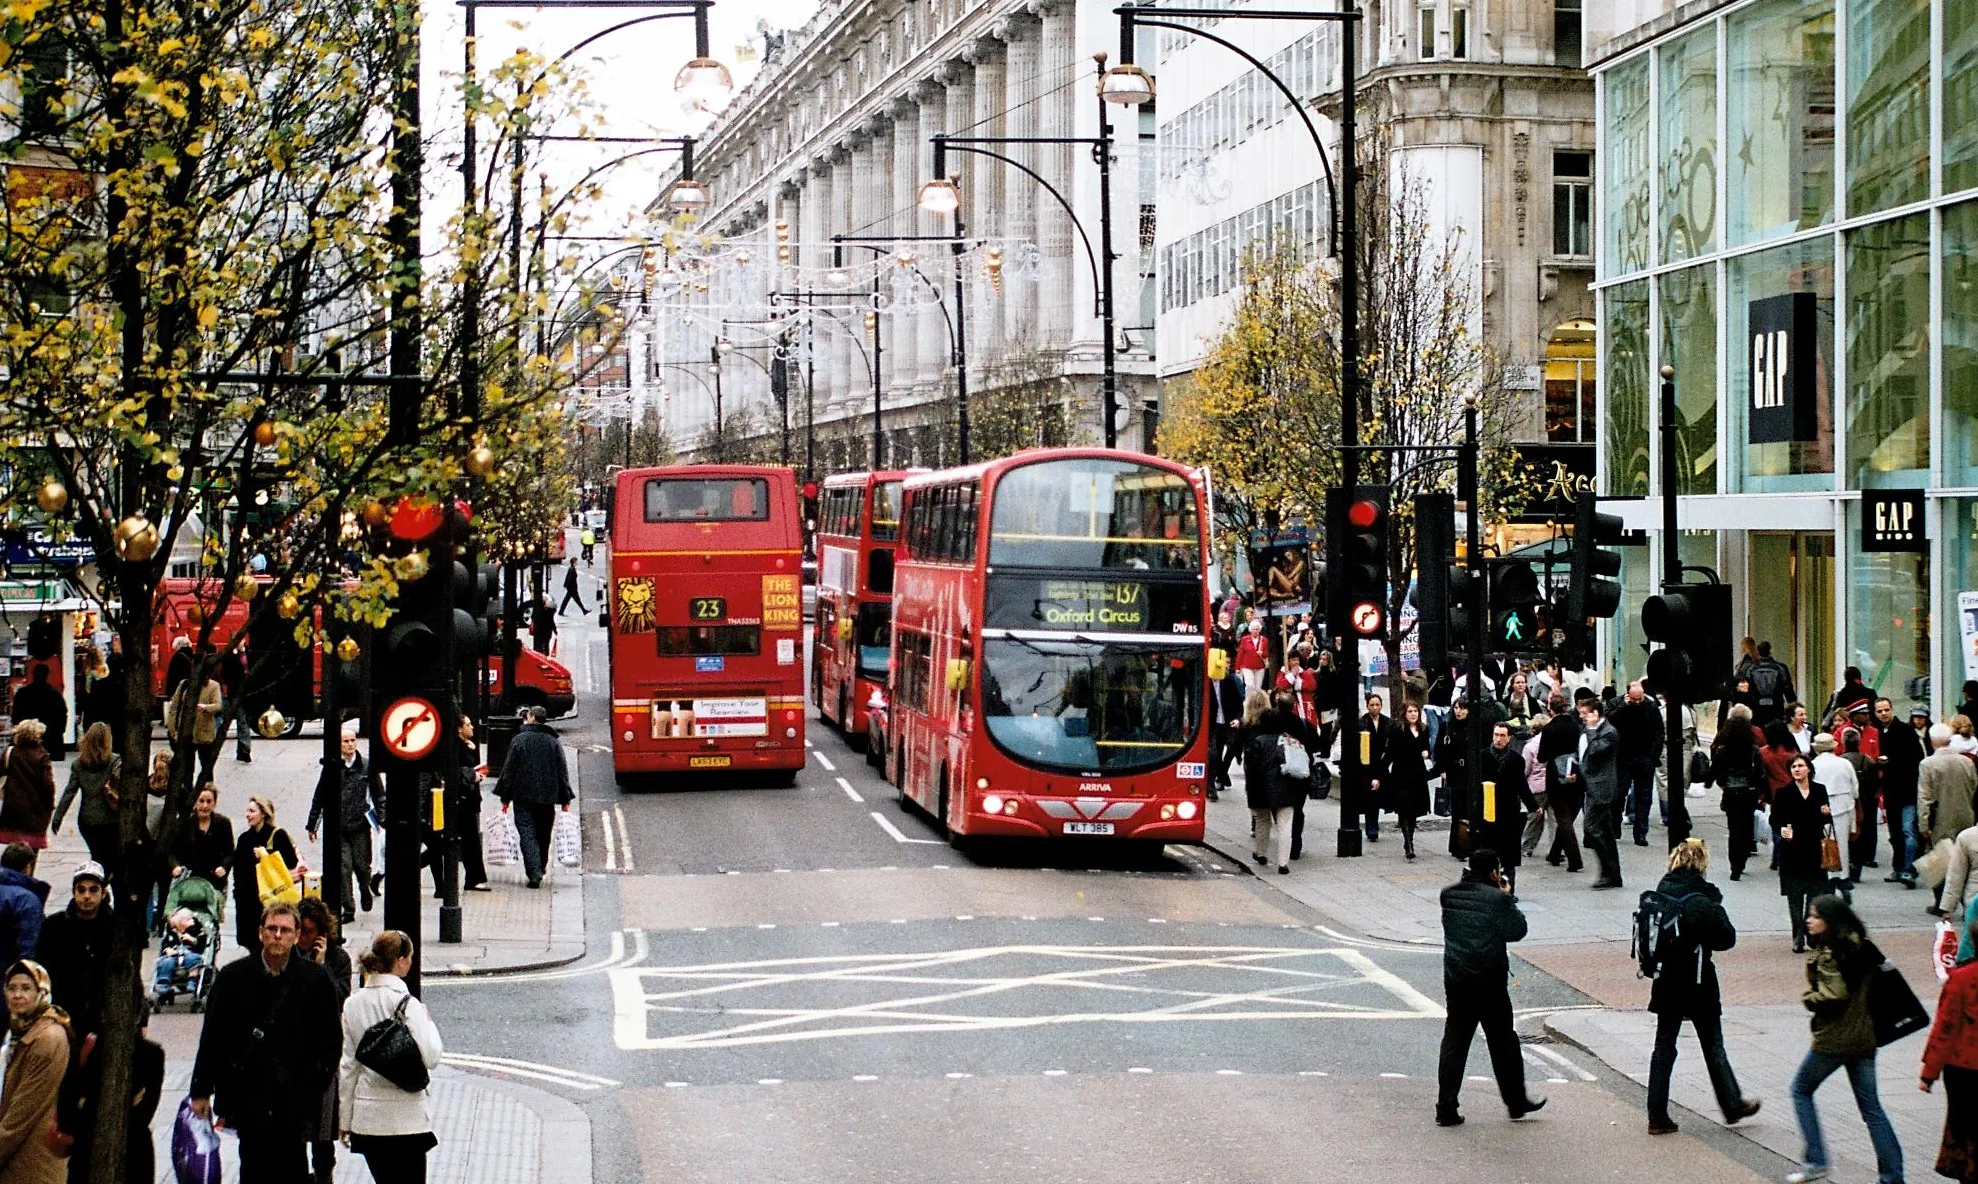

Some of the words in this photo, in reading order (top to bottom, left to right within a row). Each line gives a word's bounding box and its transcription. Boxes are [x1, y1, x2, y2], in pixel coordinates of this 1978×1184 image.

[1754, 330, 1787, 409] GAP
[1875, 501, 1913, 531] GAP
[769, 580, 792, 591] THE
[1116, 583, 1140, 604] 137
[764, 594, 799, 606] LION
[697, 600, 720, 618] 23
[764, 609, 799, 621] KING
[1046, 609, 1095, 623] Oxford
[1098, 609, 1141, 623] Circus
[1172, 623, 1188, 633] DW
[1079, 783, 1112, 792] ARRIVA
[1070, 823, 1086, 832] WLT
